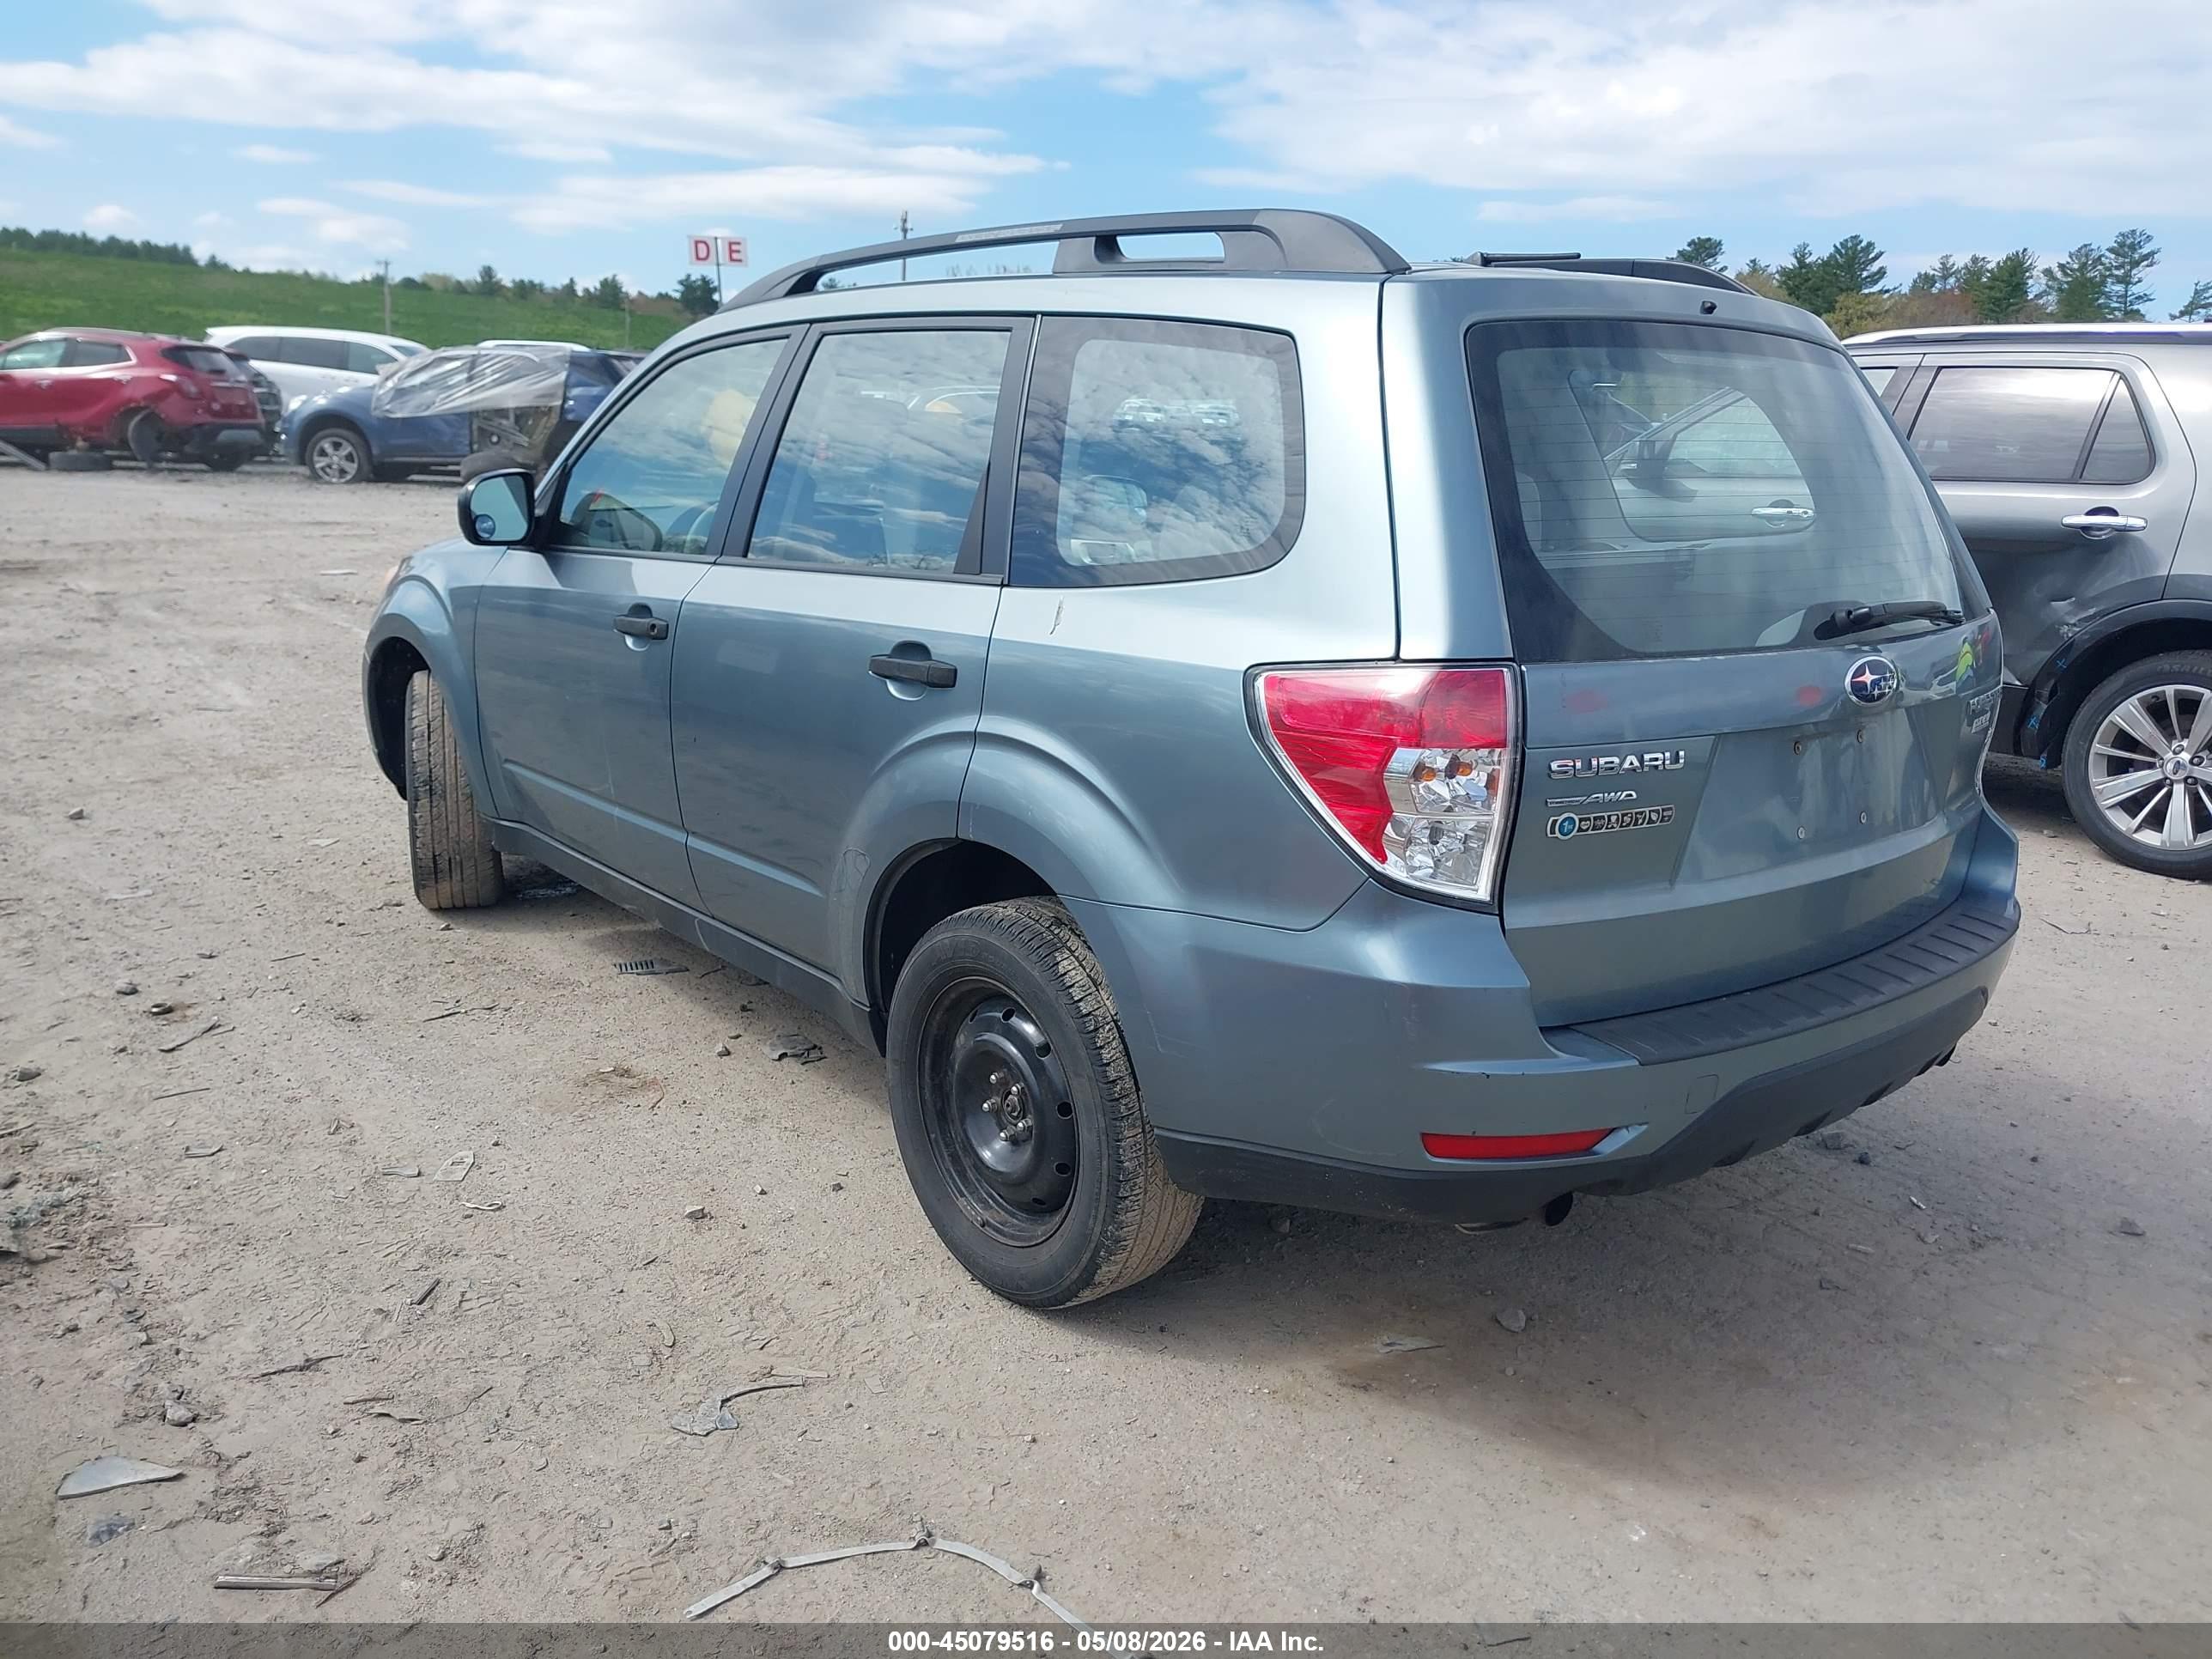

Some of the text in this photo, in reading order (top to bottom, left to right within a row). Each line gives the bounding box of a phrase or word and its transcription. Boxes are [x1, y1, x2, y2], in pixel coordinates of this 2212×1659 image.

[694, 240, 743, 263] D E
[1549, 750, 1686, 780] SUBARU
[1582, 790, 1638, 805] AWD
